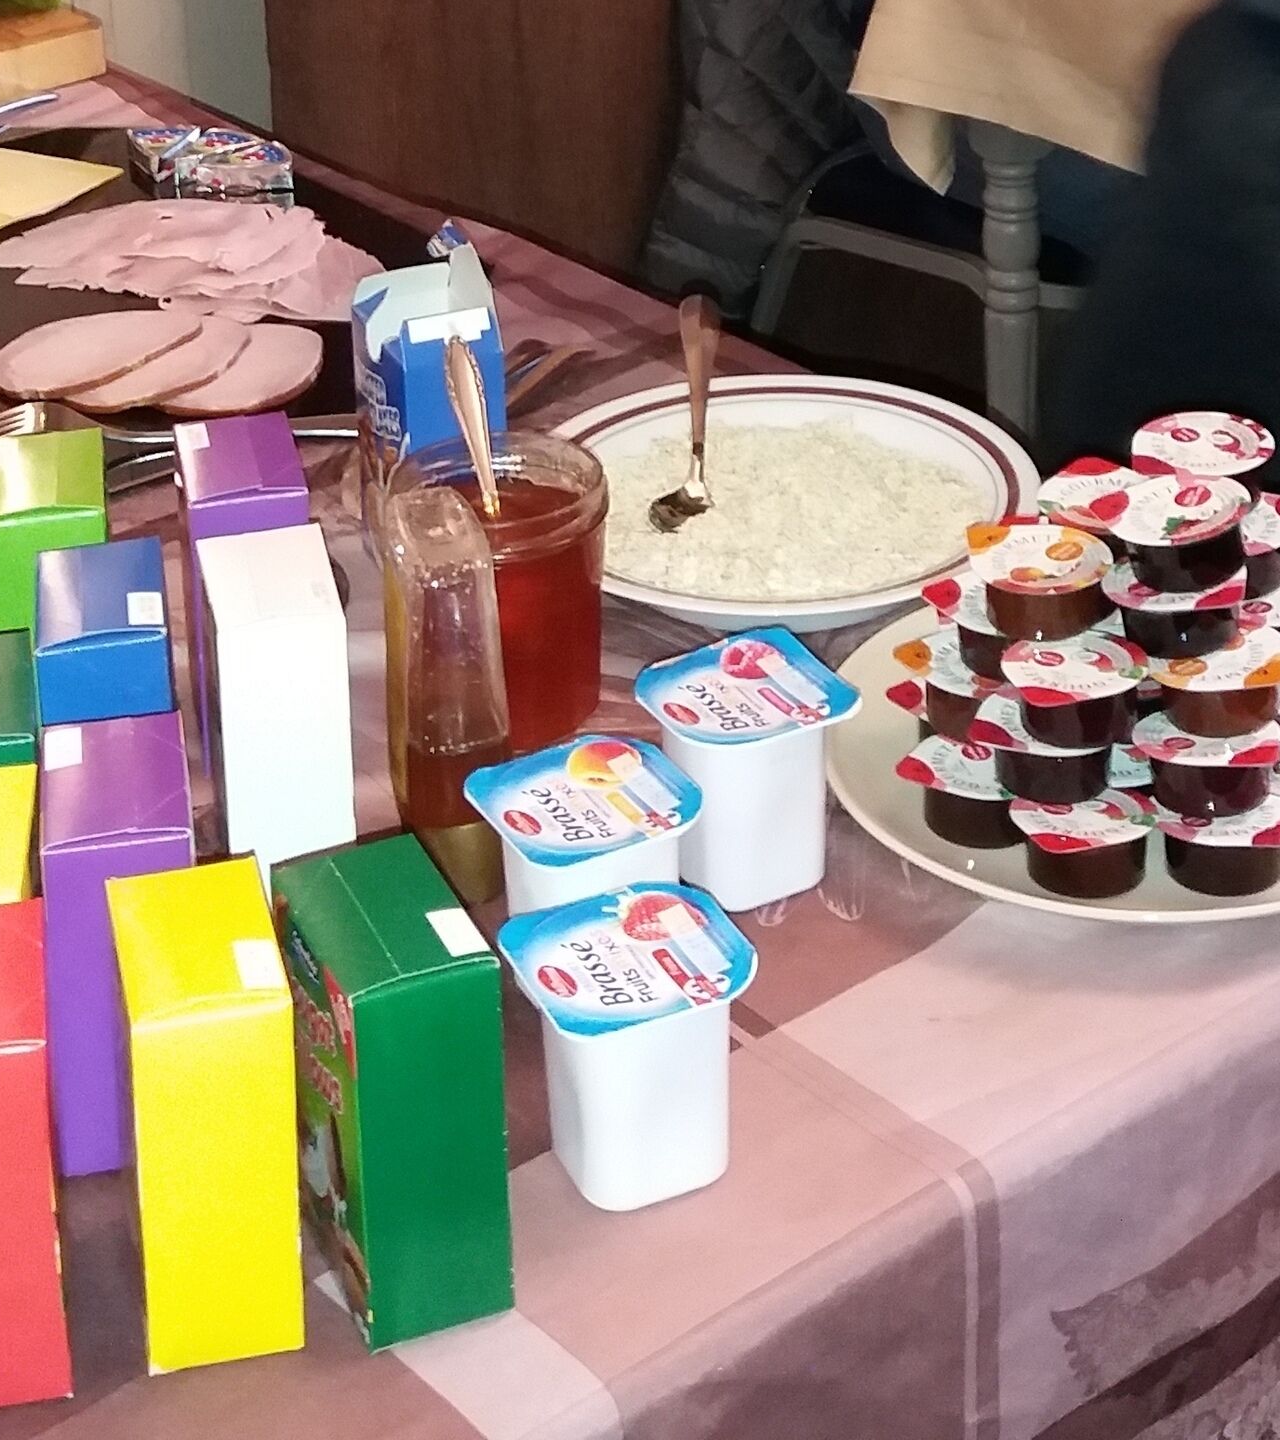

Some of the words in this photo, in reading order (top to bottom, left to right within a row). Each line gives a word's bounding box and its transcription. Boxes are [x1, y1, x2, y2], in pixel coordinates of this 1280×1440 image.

[677, 683, 750, 731] Brassé
[521, 786, 595, 843] Brassé
[581, 808, 619, 839] Fruits
[560, 939, 635, 1007] Brassé
[623, 968, 660, 1004] Fruits
